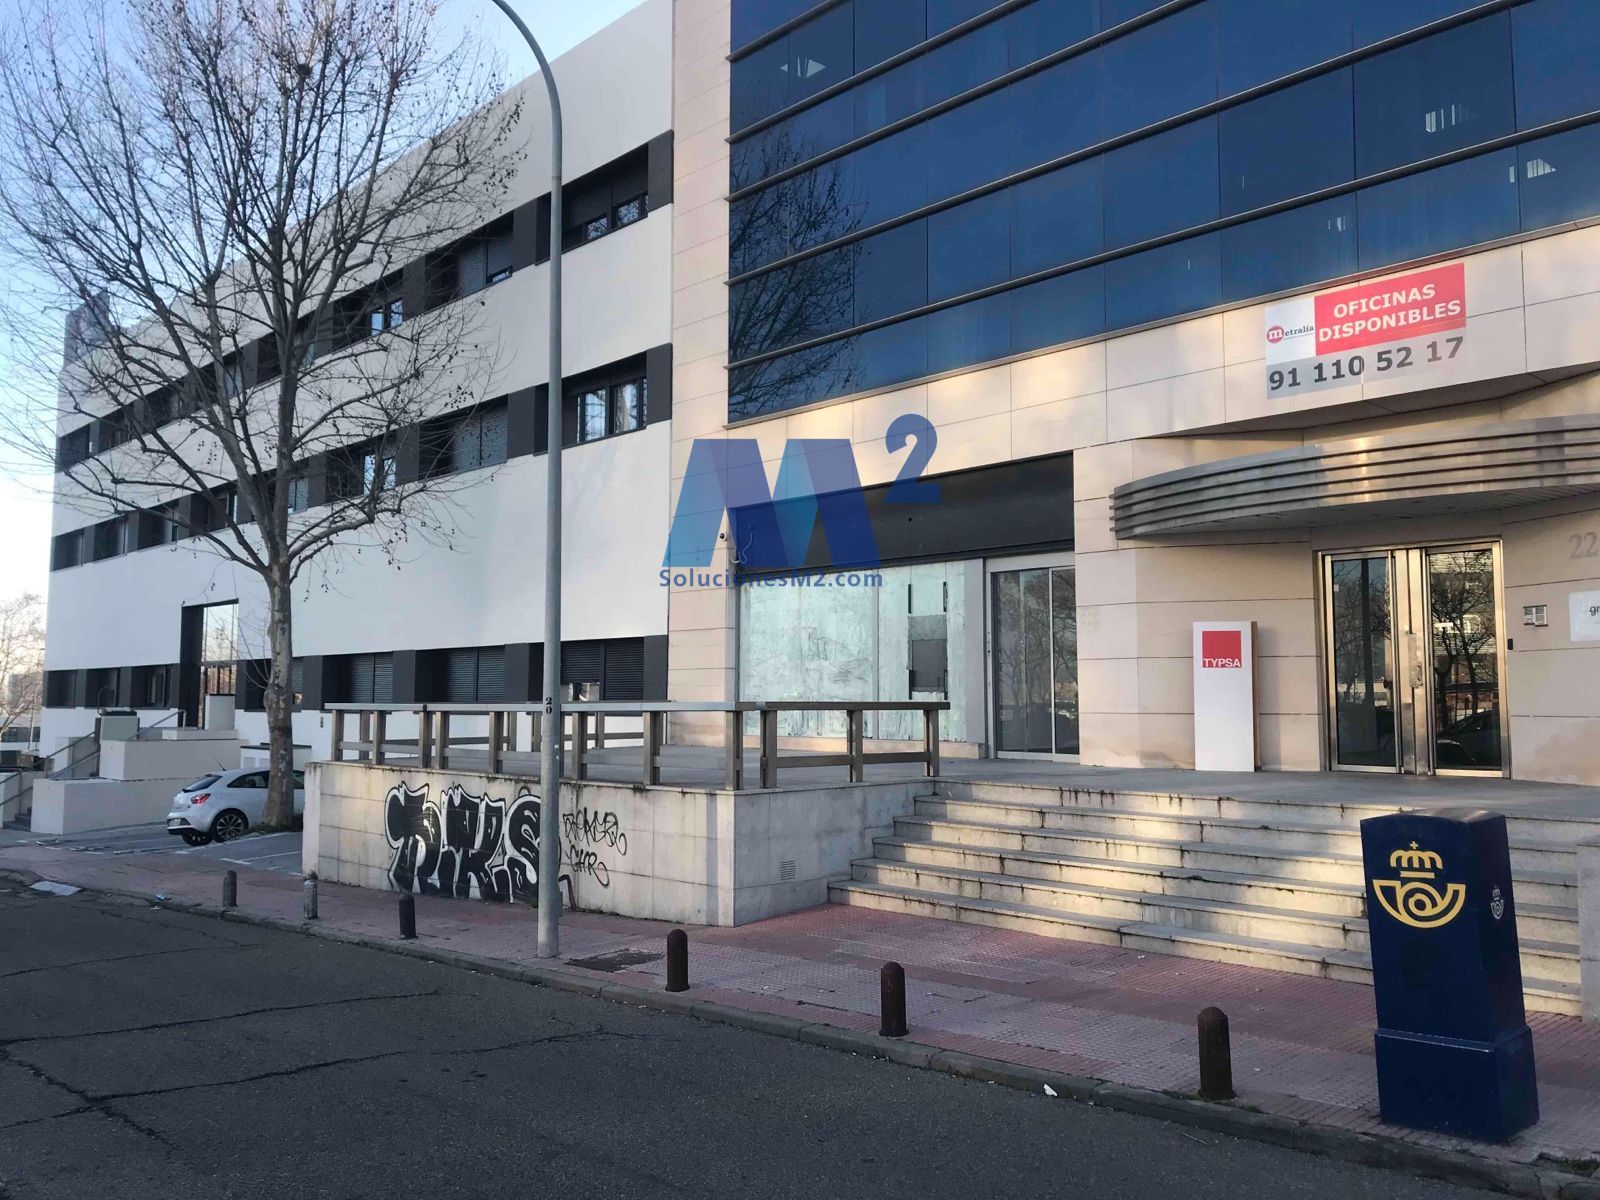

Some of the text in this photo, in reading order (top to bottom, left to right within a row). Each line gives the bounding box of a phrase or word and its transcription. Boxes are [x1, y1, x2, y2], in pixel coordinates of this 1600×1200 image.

[1333, 283, 1436, 318] OFICINAS
[1267, 325, 1314, 343] metralia
[1318, 300, 1462, 342] DISPONIBLES
[1269, 336, 1464, 391] 91 110 52 17
[1203, 658, 1240, 668] TYPSA
